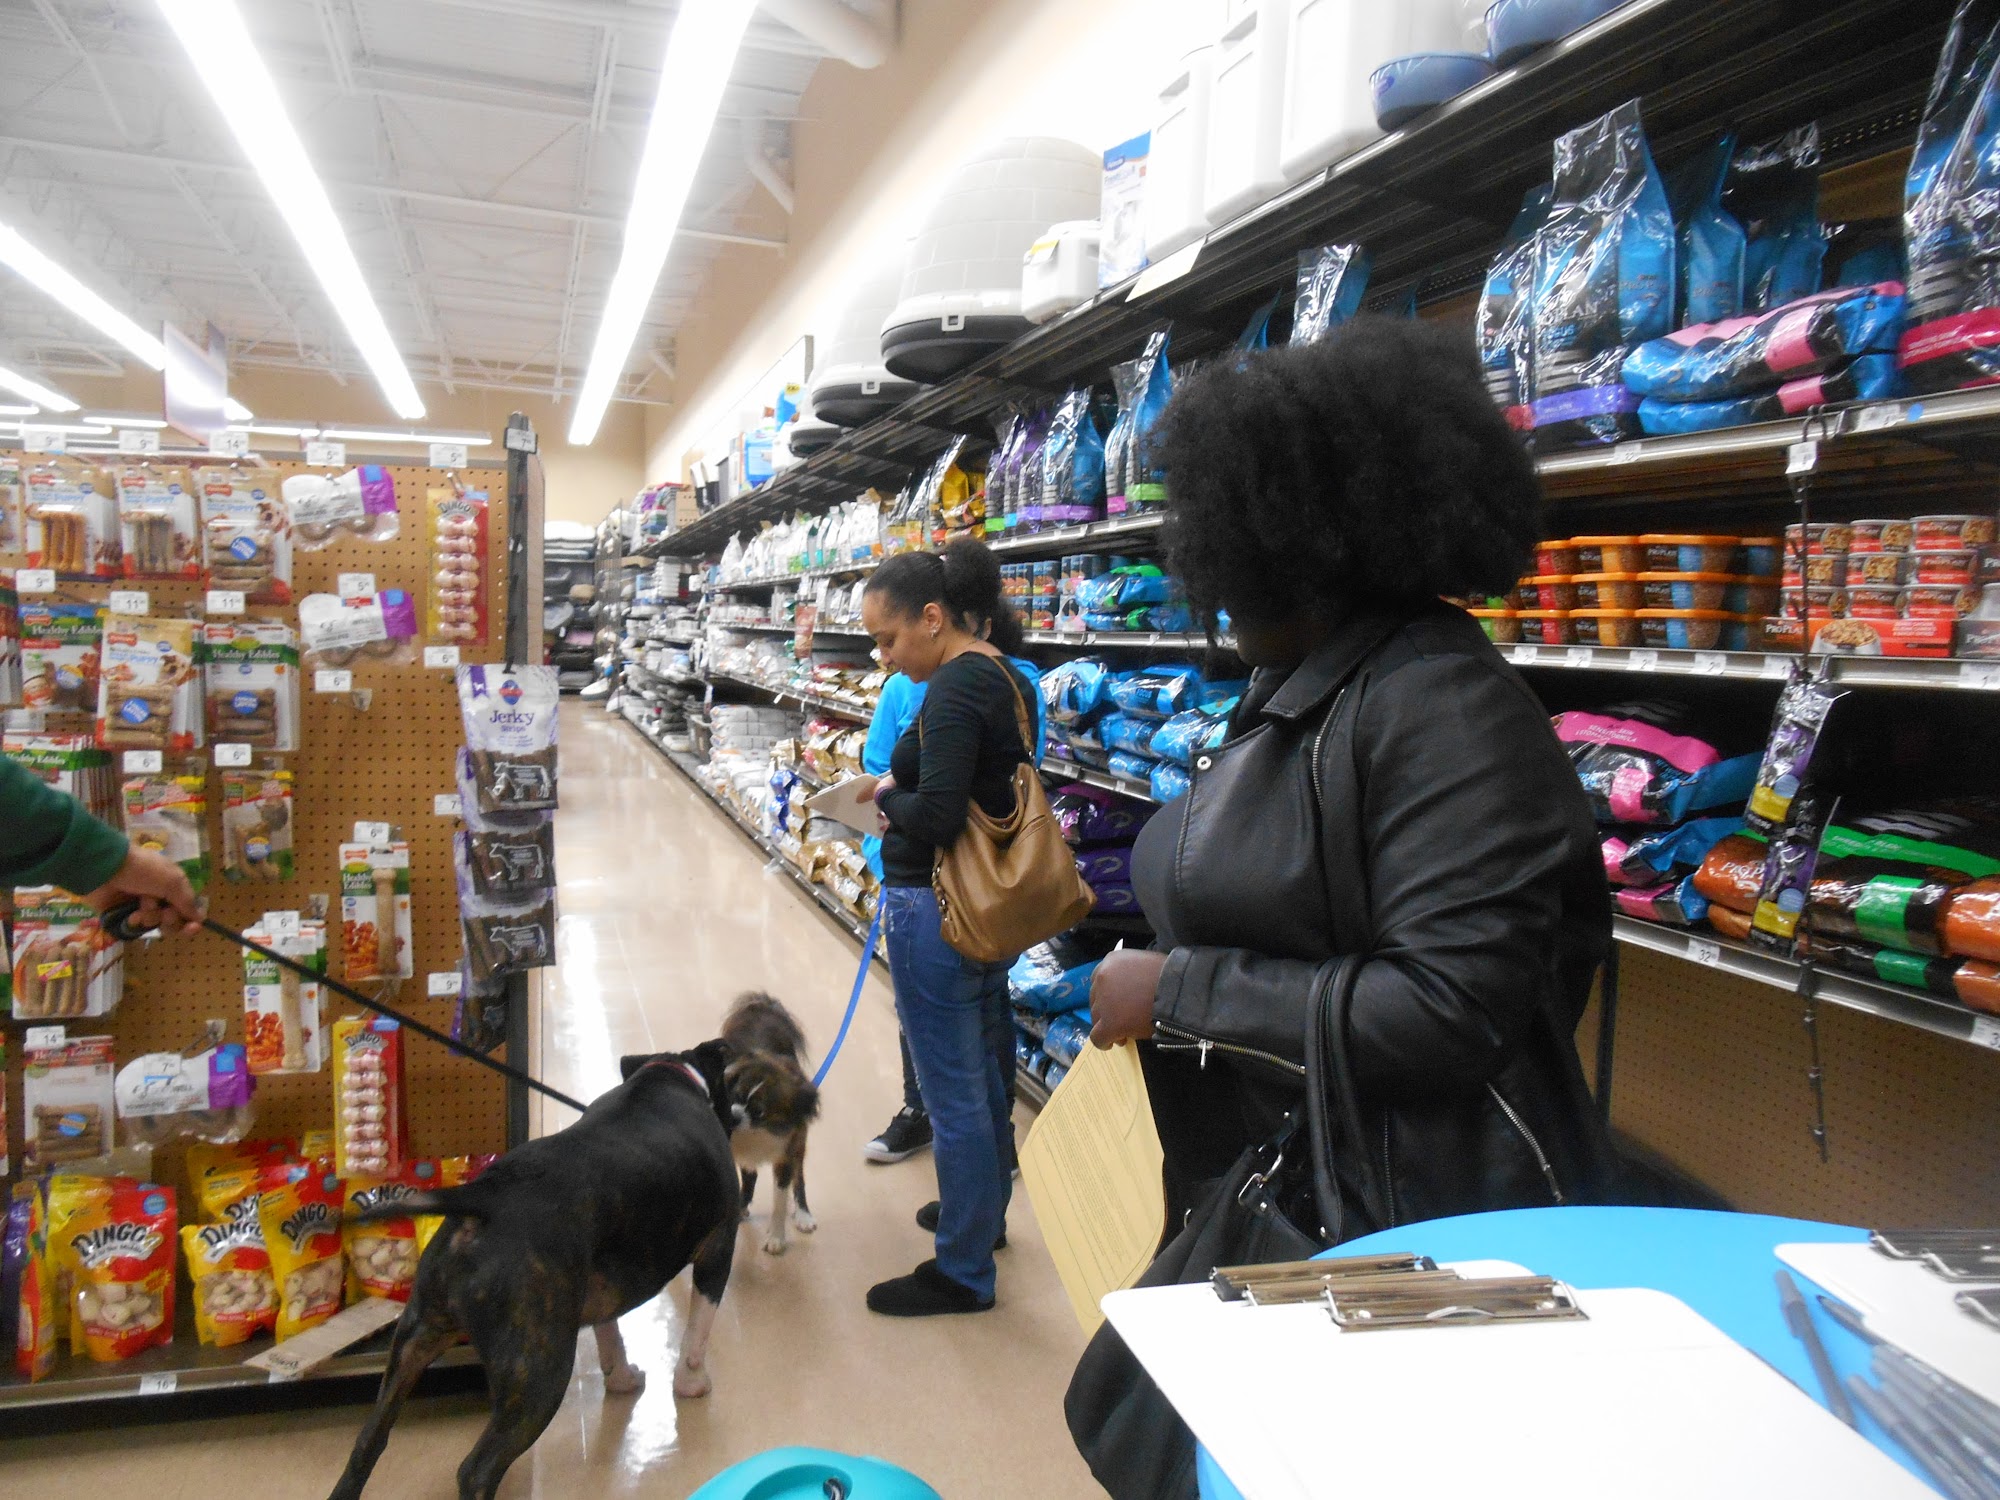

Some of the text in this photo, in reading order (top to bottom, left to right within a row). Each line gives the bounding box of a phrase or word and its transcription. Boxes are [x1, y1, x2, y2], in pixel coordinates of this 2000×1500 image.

[437, 501, 471, 513] DINGO
[490, 709, 534, 726] Jerky
[344, 1032, 381, 1048] DINGO
[280, 1203, 328, 1242] DINGO
[71, 1222, 147, 1257] DINGO
